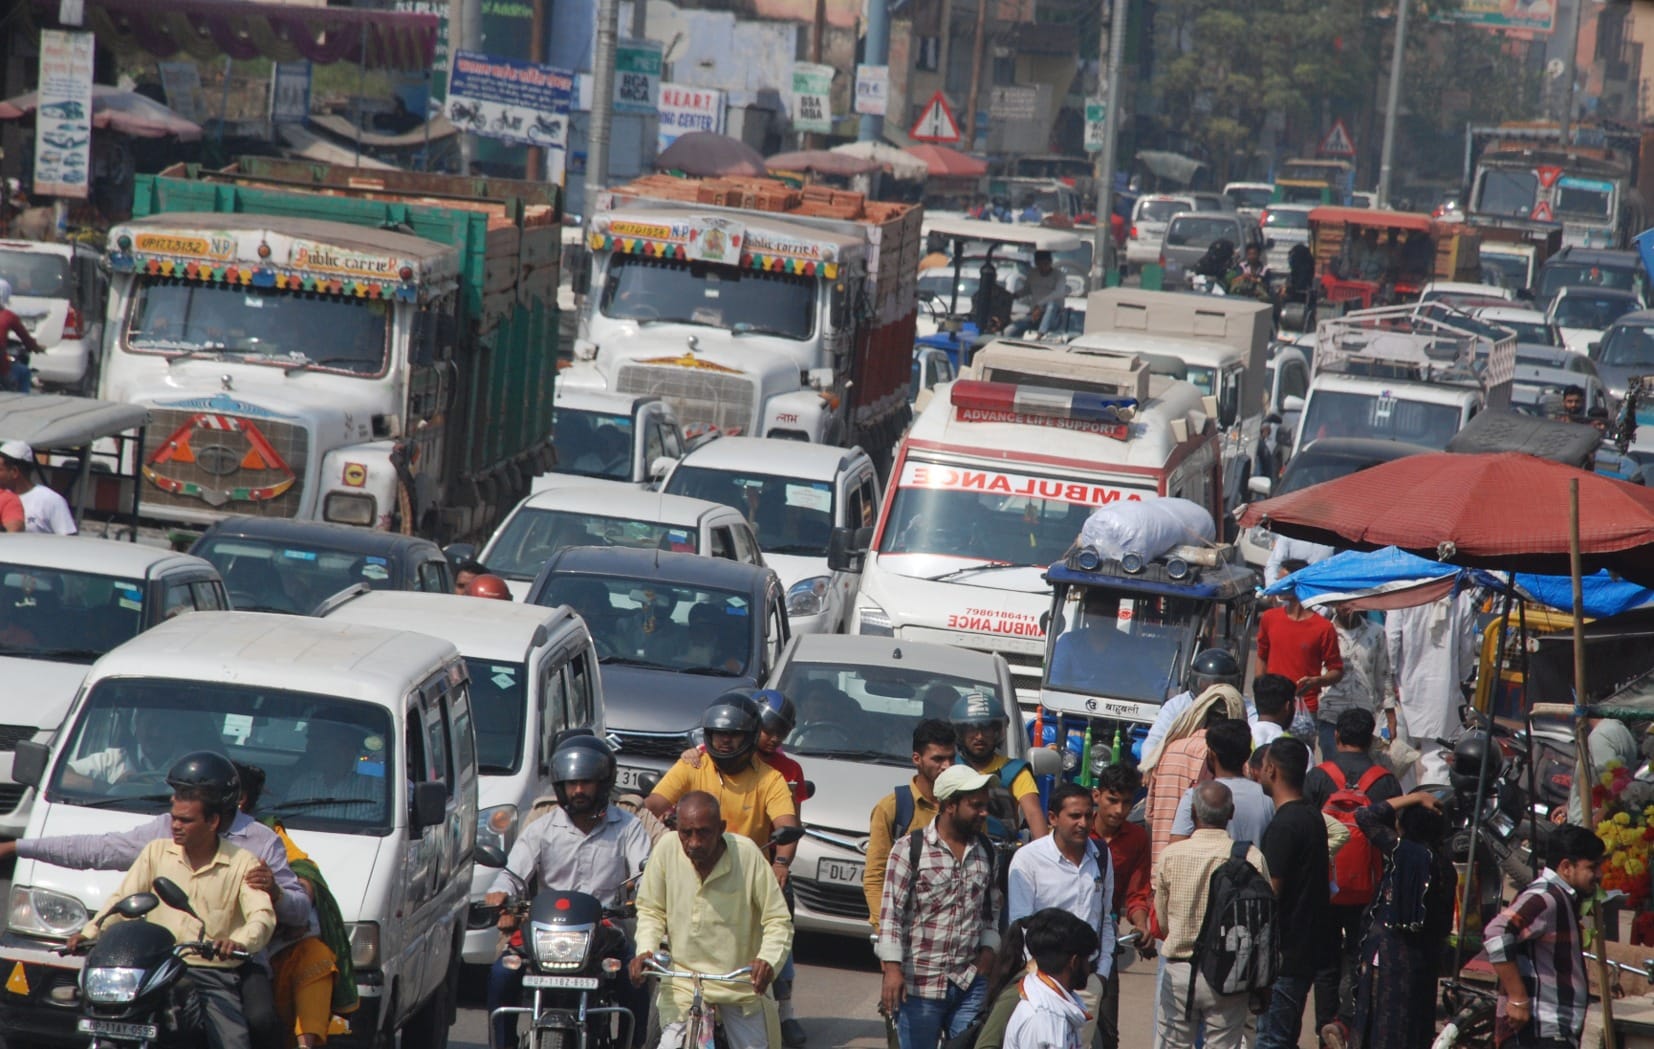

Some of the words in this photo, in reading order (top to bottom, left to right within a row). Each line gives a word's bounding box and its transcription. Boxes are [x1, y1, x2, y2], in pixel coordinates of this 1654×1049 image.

[663, 89, 712, 112] HEART
[678, 112, 713, 130] CENTER
[962, 408, 1024, 424] ADVANCE
[1026, 413, 1054, 427] LIFE
[1056, 416, 1118, 435] SUPPORT
